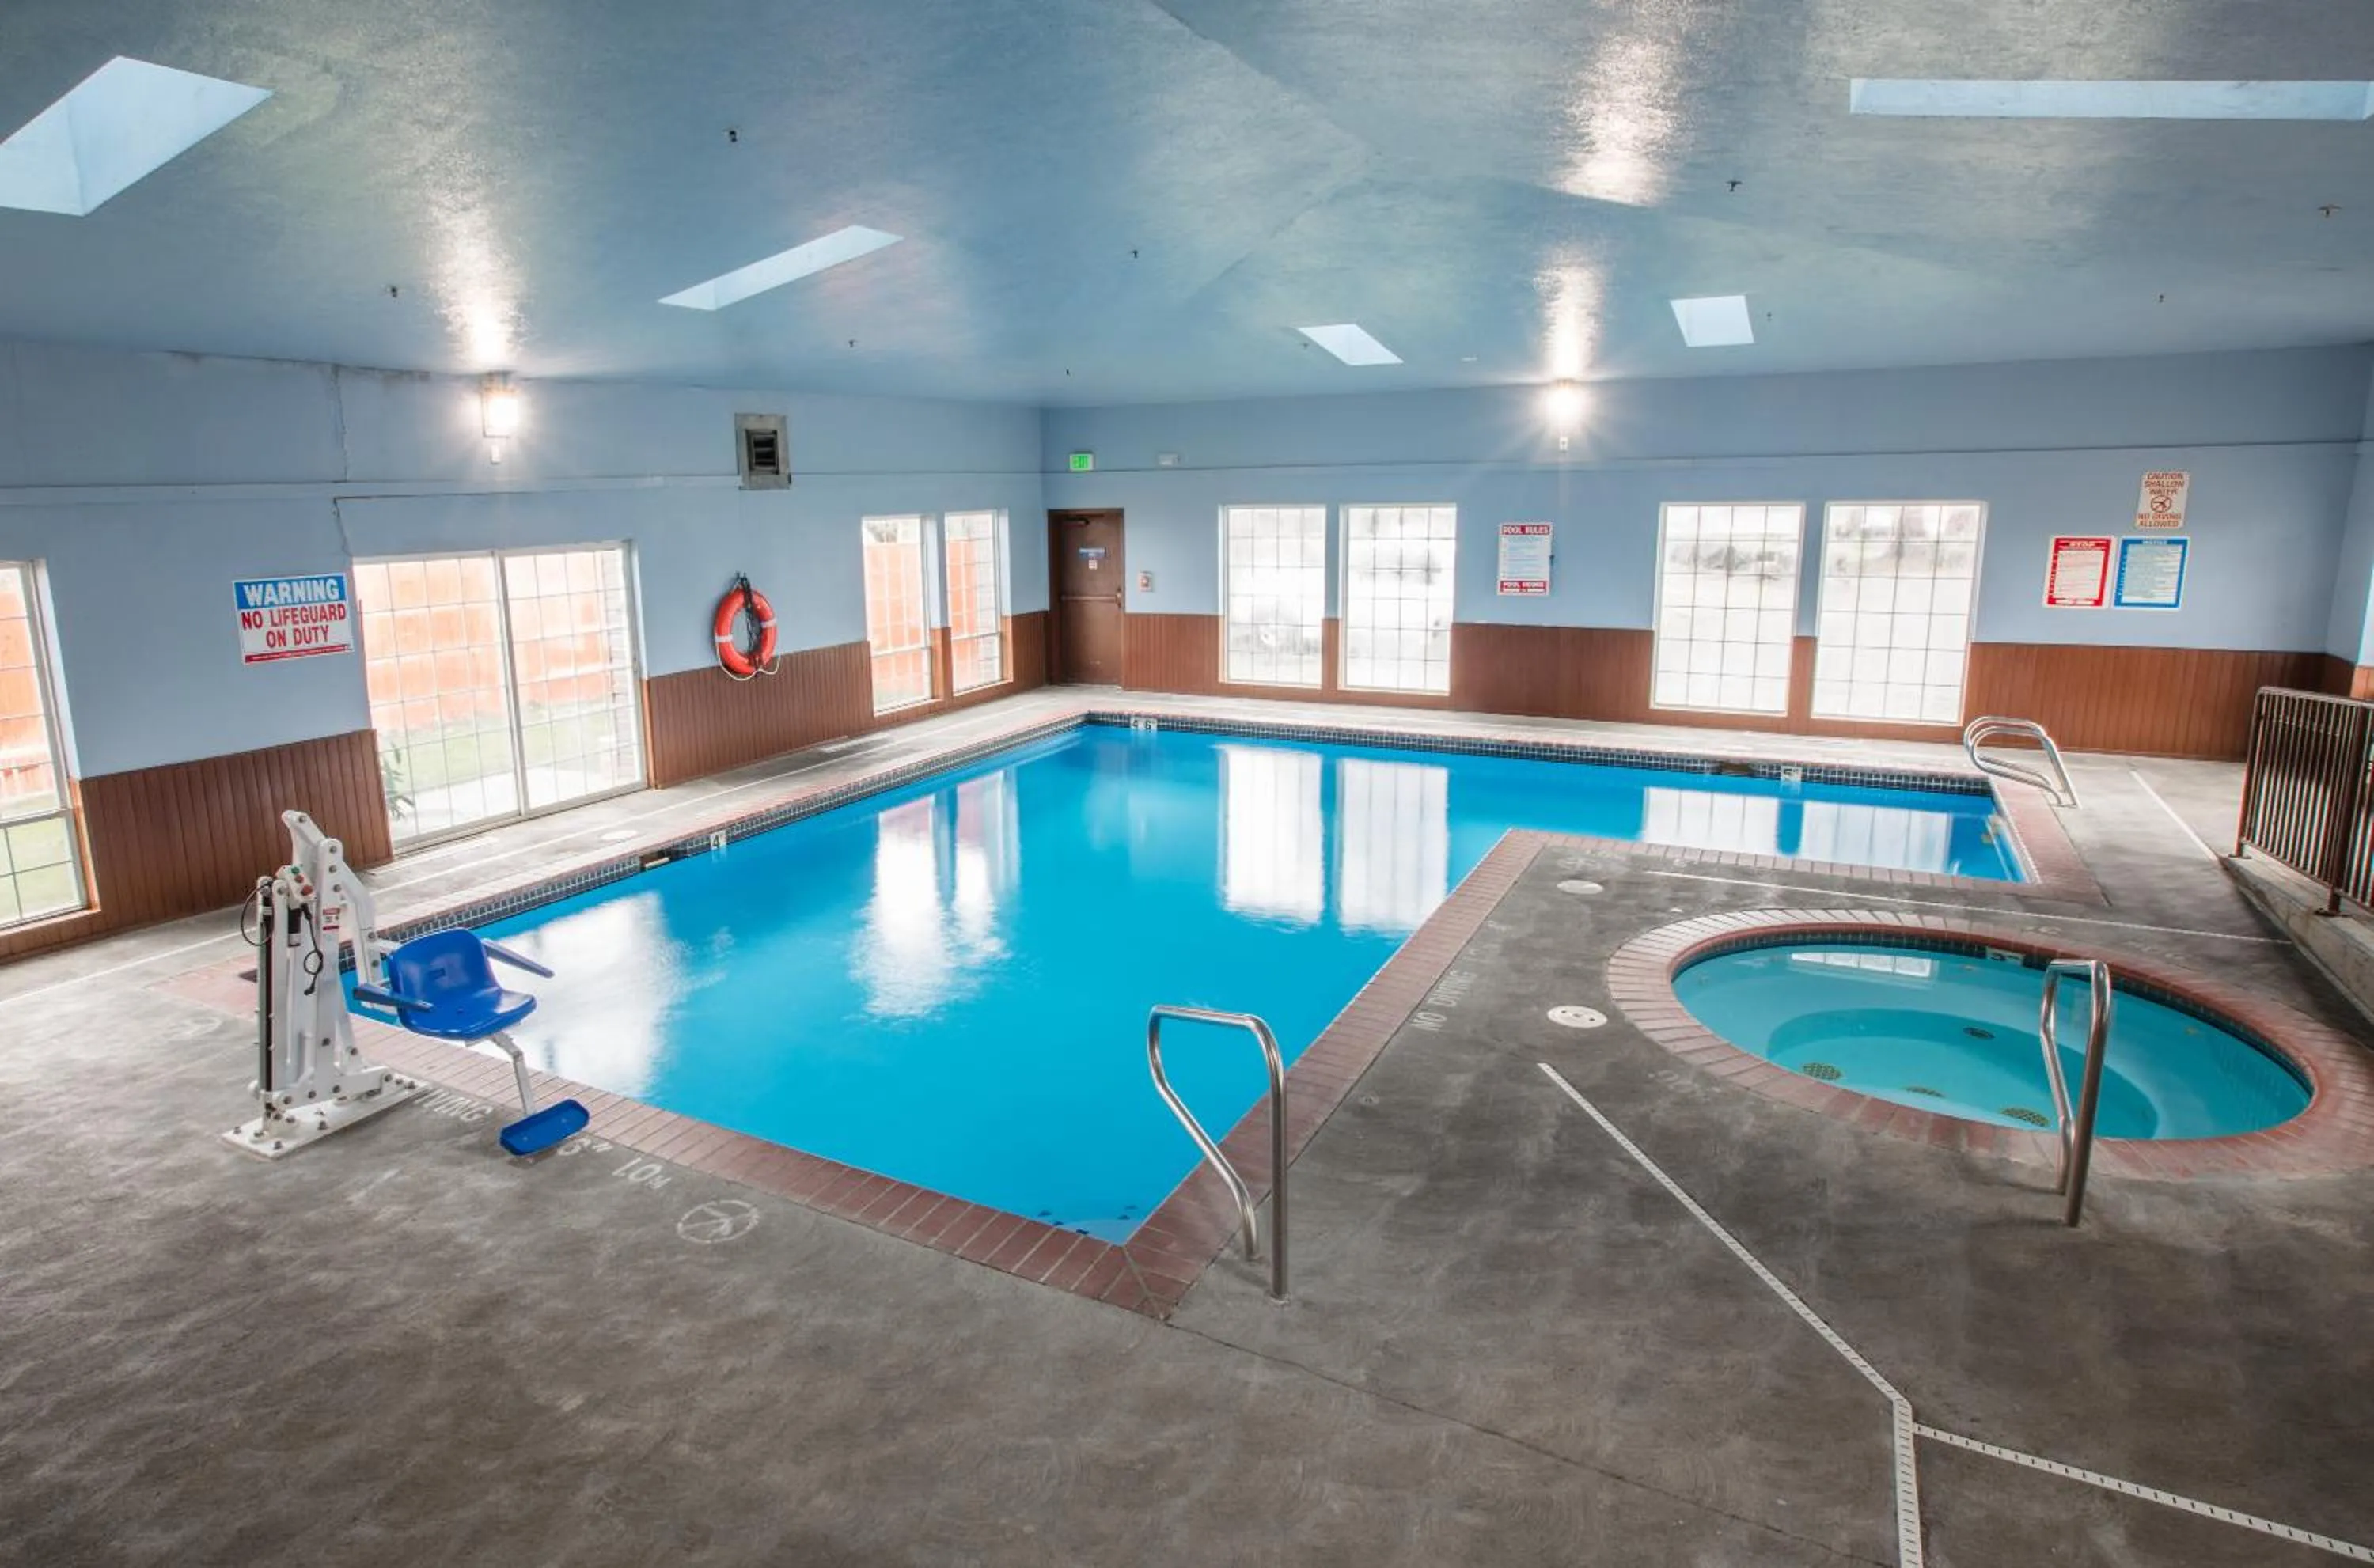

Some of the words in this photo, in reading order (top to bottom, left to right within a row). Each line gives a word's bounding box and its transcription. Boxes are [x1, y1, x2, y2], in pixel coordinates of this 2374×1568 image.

[243, 578, 339, 607] WARNING
[241, 611, 264, 630] NO
[270, 603, 347, 627] LIFEGUARD
[266, 630, 286, 648] ON
[294, 625, 329, 646] DUTY
[1411, 1011, 1447, 1031] NO
[413, 1088, 493, 1122] IVING
